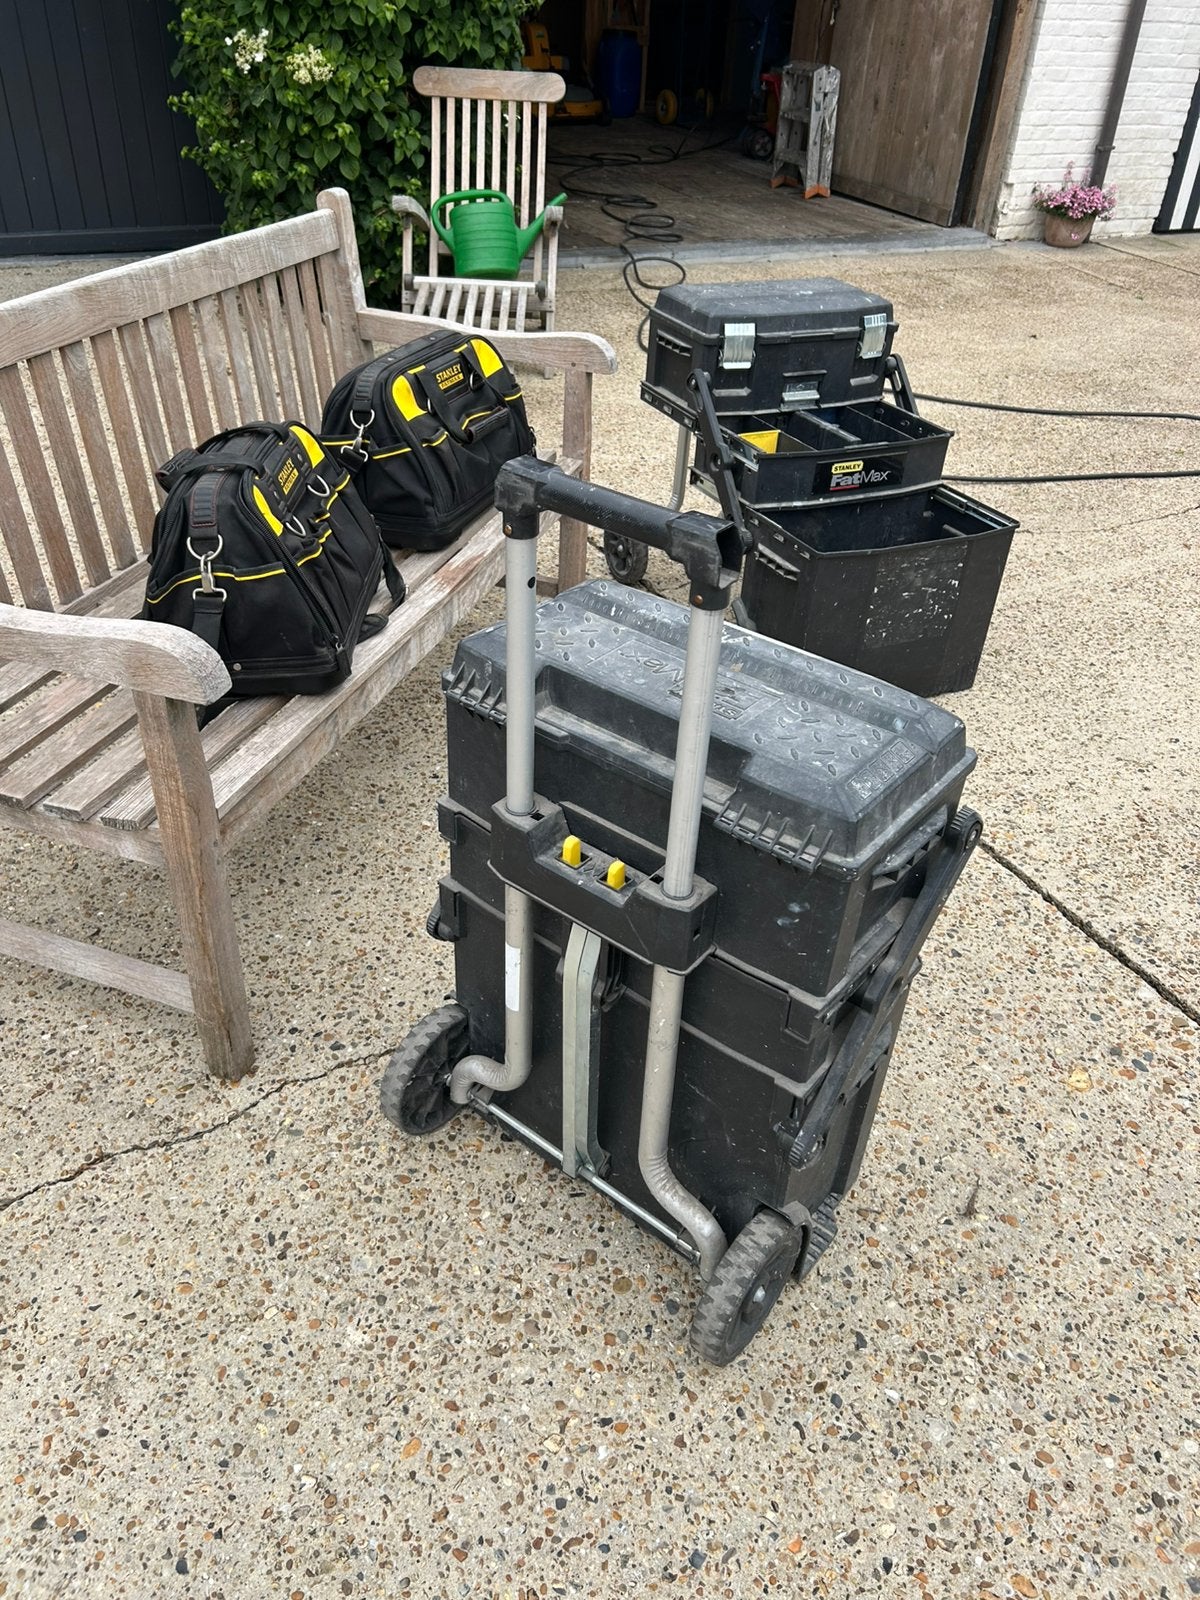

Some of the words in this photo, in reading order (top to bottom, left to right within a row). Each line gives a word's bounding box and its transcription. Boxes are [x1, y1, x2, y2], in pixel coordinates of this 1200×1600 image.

[436, 363, 461, 383] STANLEY
[278, 457, 294, 486] STANLEY
[833, 462, 862, 472] STANLEY
[830, 469, 890, 487] FatMax
